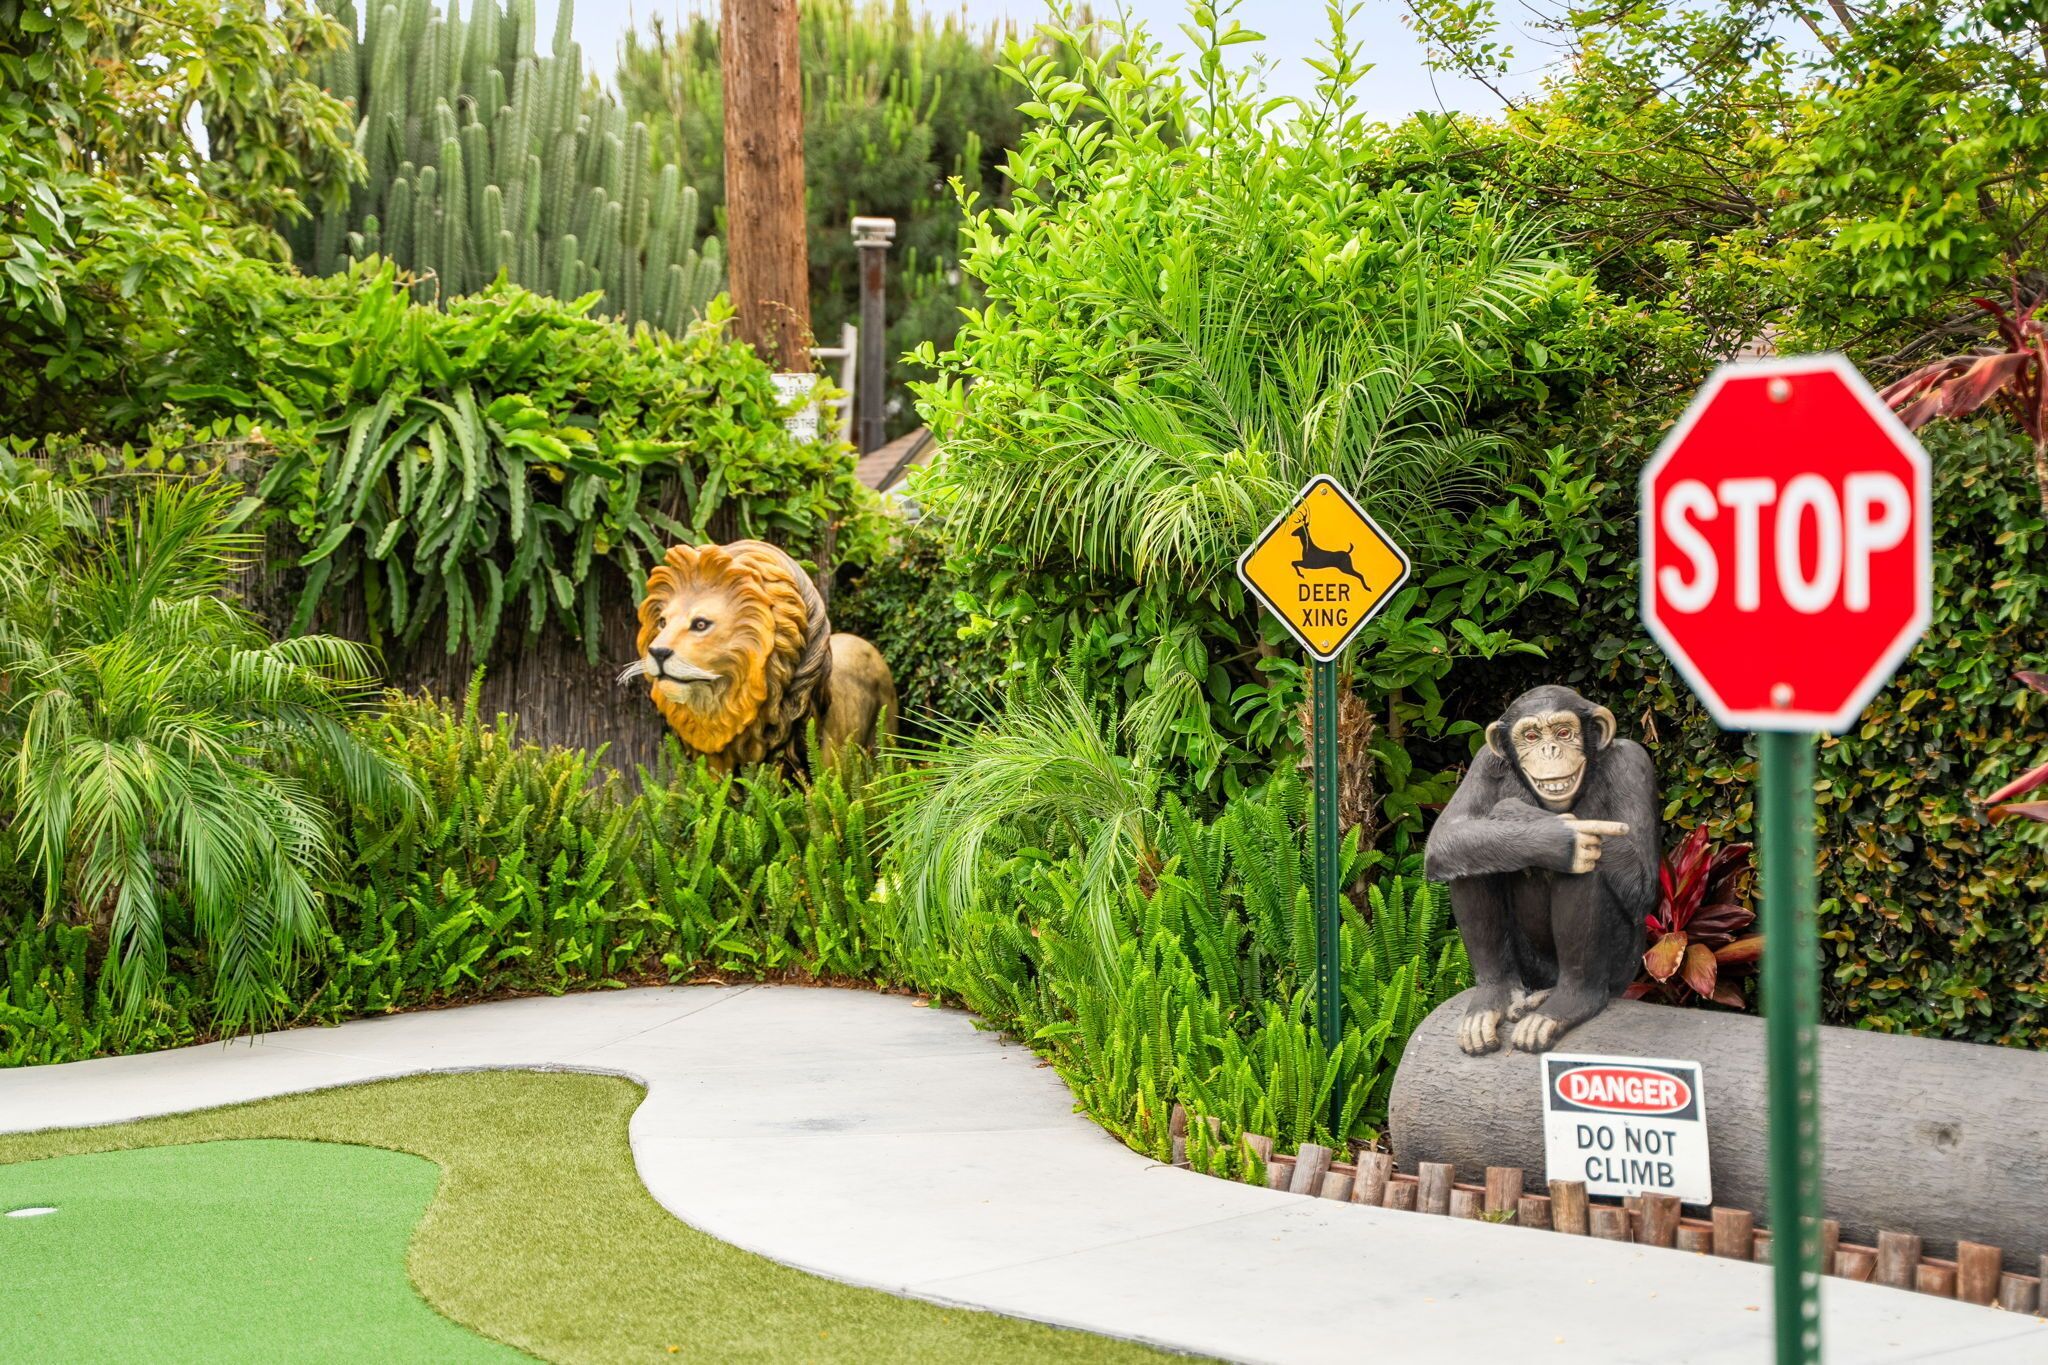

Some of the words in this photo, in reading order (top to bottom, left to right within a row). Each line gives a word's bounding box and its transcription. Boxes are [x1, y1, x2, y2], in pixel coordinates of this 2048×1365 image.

[801, 418, 816, 429] THE
[1657, 470, 1912, 614] STOP
[1298, 583, 1351, 602] DEER
[1302, 608, 1348, 627] XING
[1569, 1073, 1679, 1107] DANGER
[1576, 1124, 1615, 1151] DO
[1625, 1127, 1677, 1157] NOT
[1585, 1156, 1675, 1188] CLIMB
